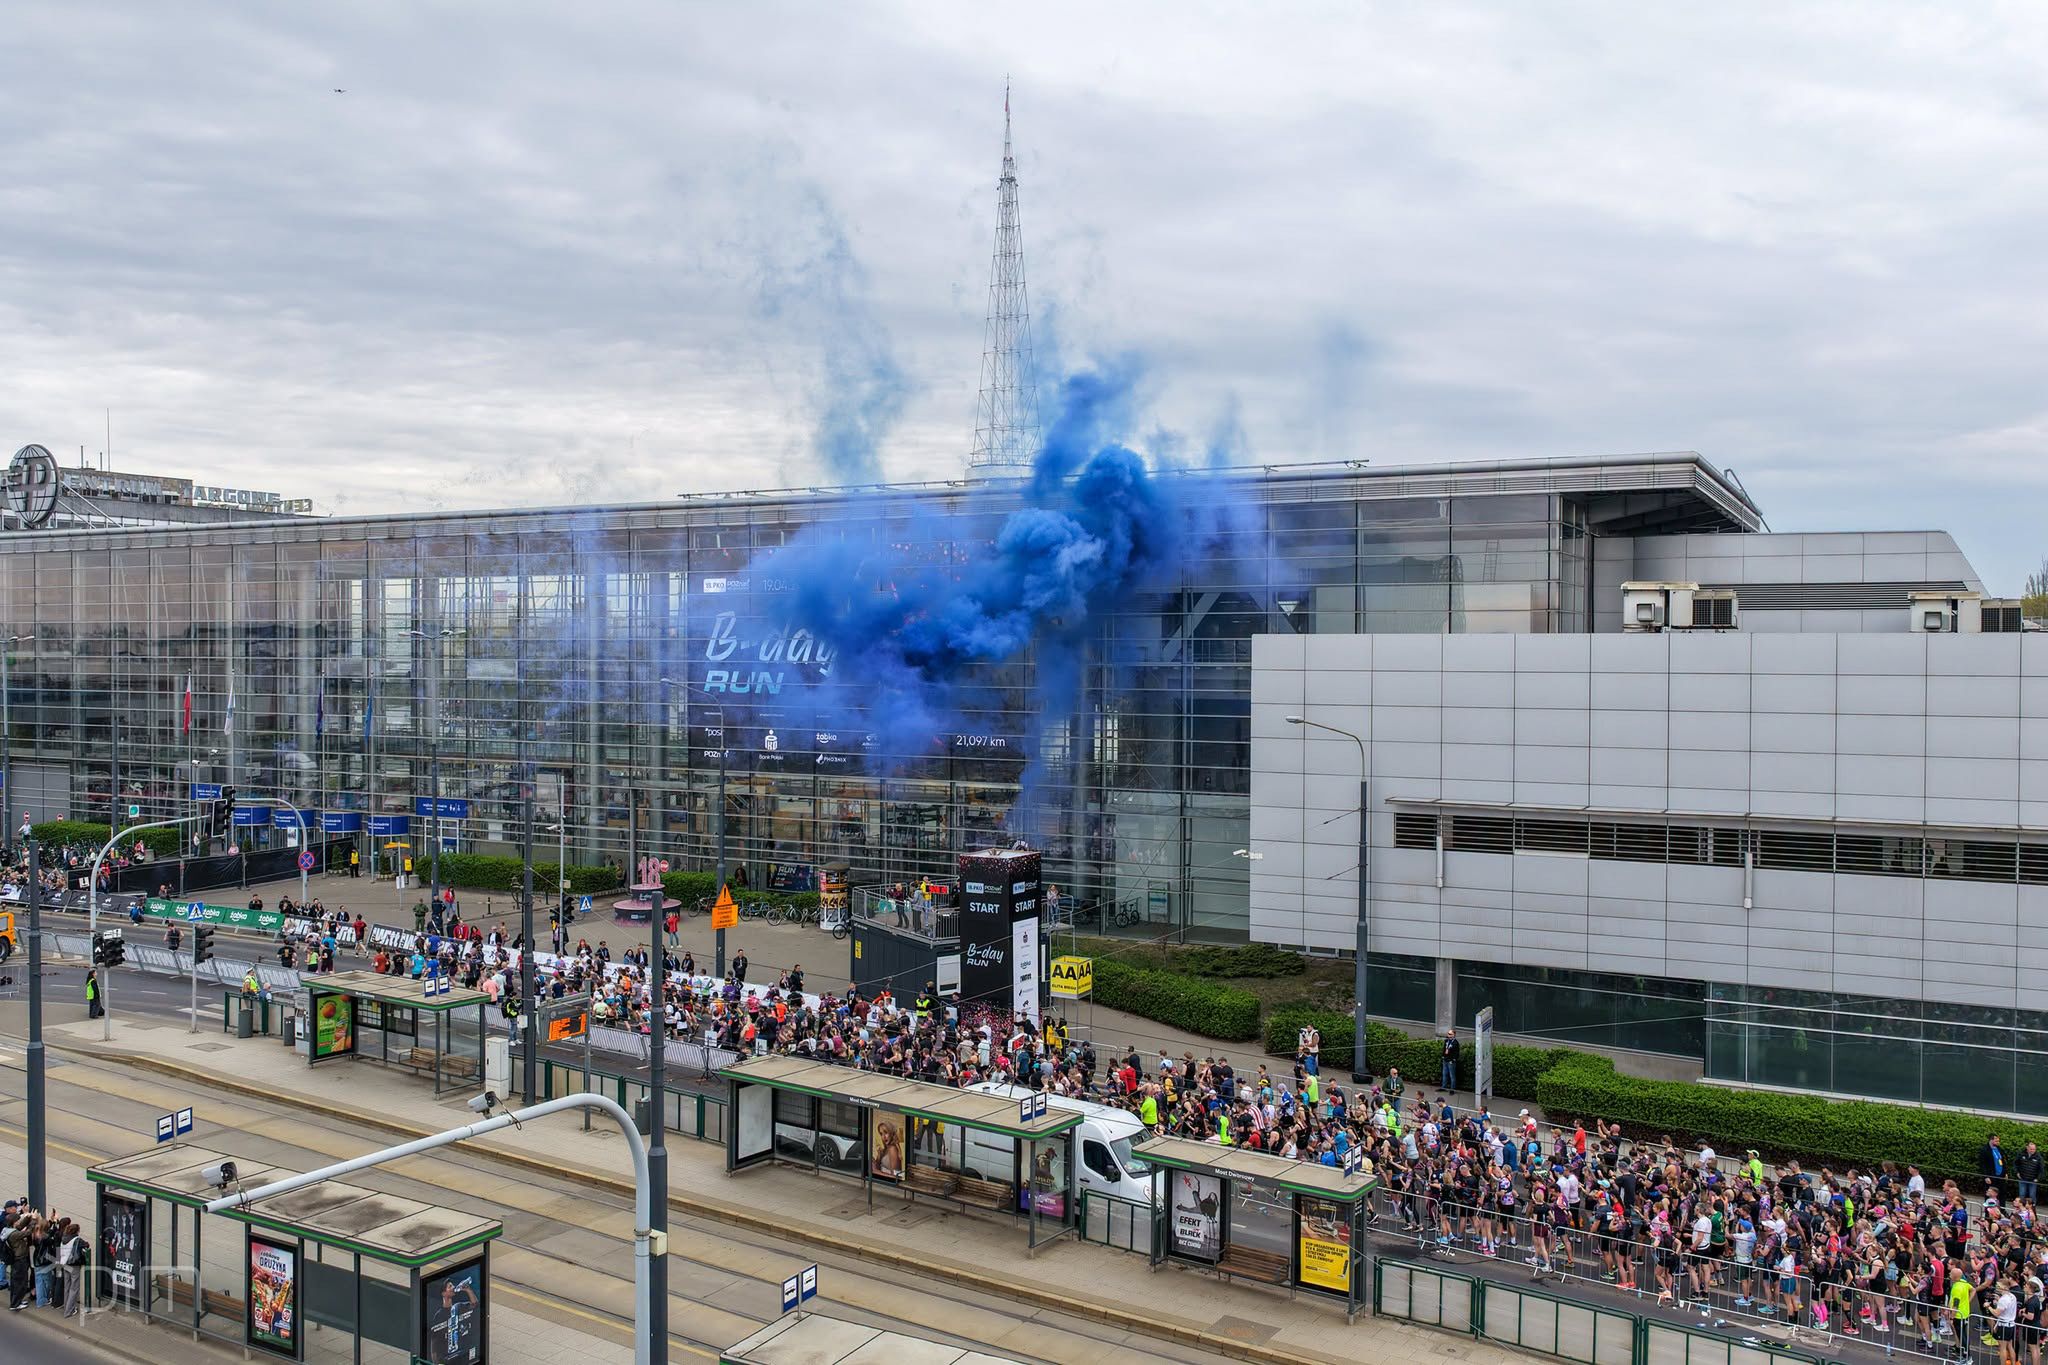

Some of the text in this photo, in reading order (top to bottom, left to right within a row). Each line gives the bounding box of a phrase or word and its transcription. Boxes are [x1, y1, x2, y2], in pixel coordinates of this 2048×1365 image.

[705, 611, 837, 677] B-day
[704, 670, 785, 695] RUN
[816, 732, 837, 743] żabka
[956, 735, 1006, 747] 21,097 km
[638, 855, 661, 887] 18
[969, 902, 1000, 914] START
[1015, 899, 1036, 913] START
[203, 907, 221, 918] żabka
[230, 911, 248, 921] żabka
[258, 914, 278, 925] żabka
[967, 943, 1004, 964] B-day
[967, 958, 989, 967] RUN
[1215, 1168, 1228, 1176] Most
[1180, 1215, 1201, 1227] EFEKT
[1180, 1228, 1201, 1238] BLACK
[115, 1259, 134, 1272] EFEKT
[116, 1274, 133, 1285] BLACK
